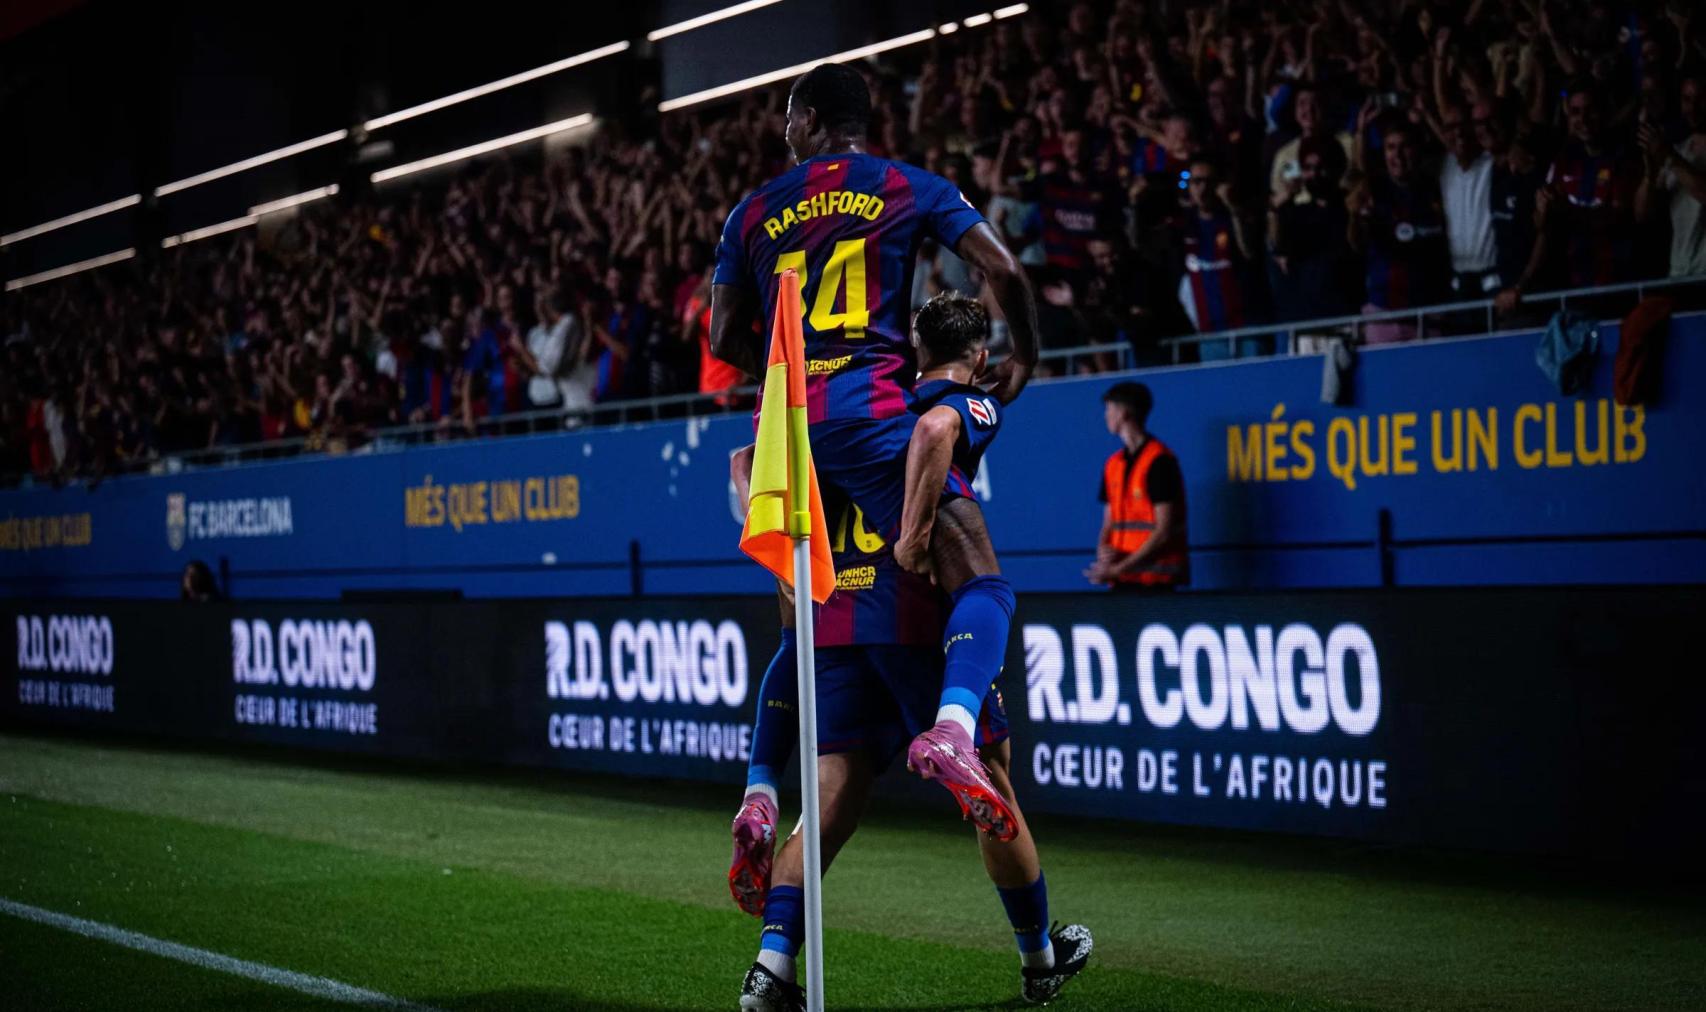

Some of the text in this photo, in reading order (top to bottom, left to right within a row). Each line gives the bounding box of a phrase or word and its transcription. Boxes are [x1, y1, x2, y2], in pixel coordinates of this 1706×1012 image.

[764, 191, 885, 240] RASHFORD
[1227, 399, 1647, 490] MÉS QUE UN CLUB
[188, 496, 293, 539] FC BARCELONA
[405, 475, 580, 533] MÉS QUE UN CLUB
[48, 614, 114, 676] CONGO
[231, 618, 377, 692] R.D. CONGO
[544, 619, 748, 707] R.D. CONGO
[1022, 622, 1382, 735] R.D. CONGO
[278, 697, 298, 728] DE
[301, 700, 378, 735] L'AFRIQUE
[609, 717, 635, 753] DE
[640, 719, 751, 764] L'AFRIQUE
[1033, 742, 1387, 808] CŒUR DE L'AFRIQUE
